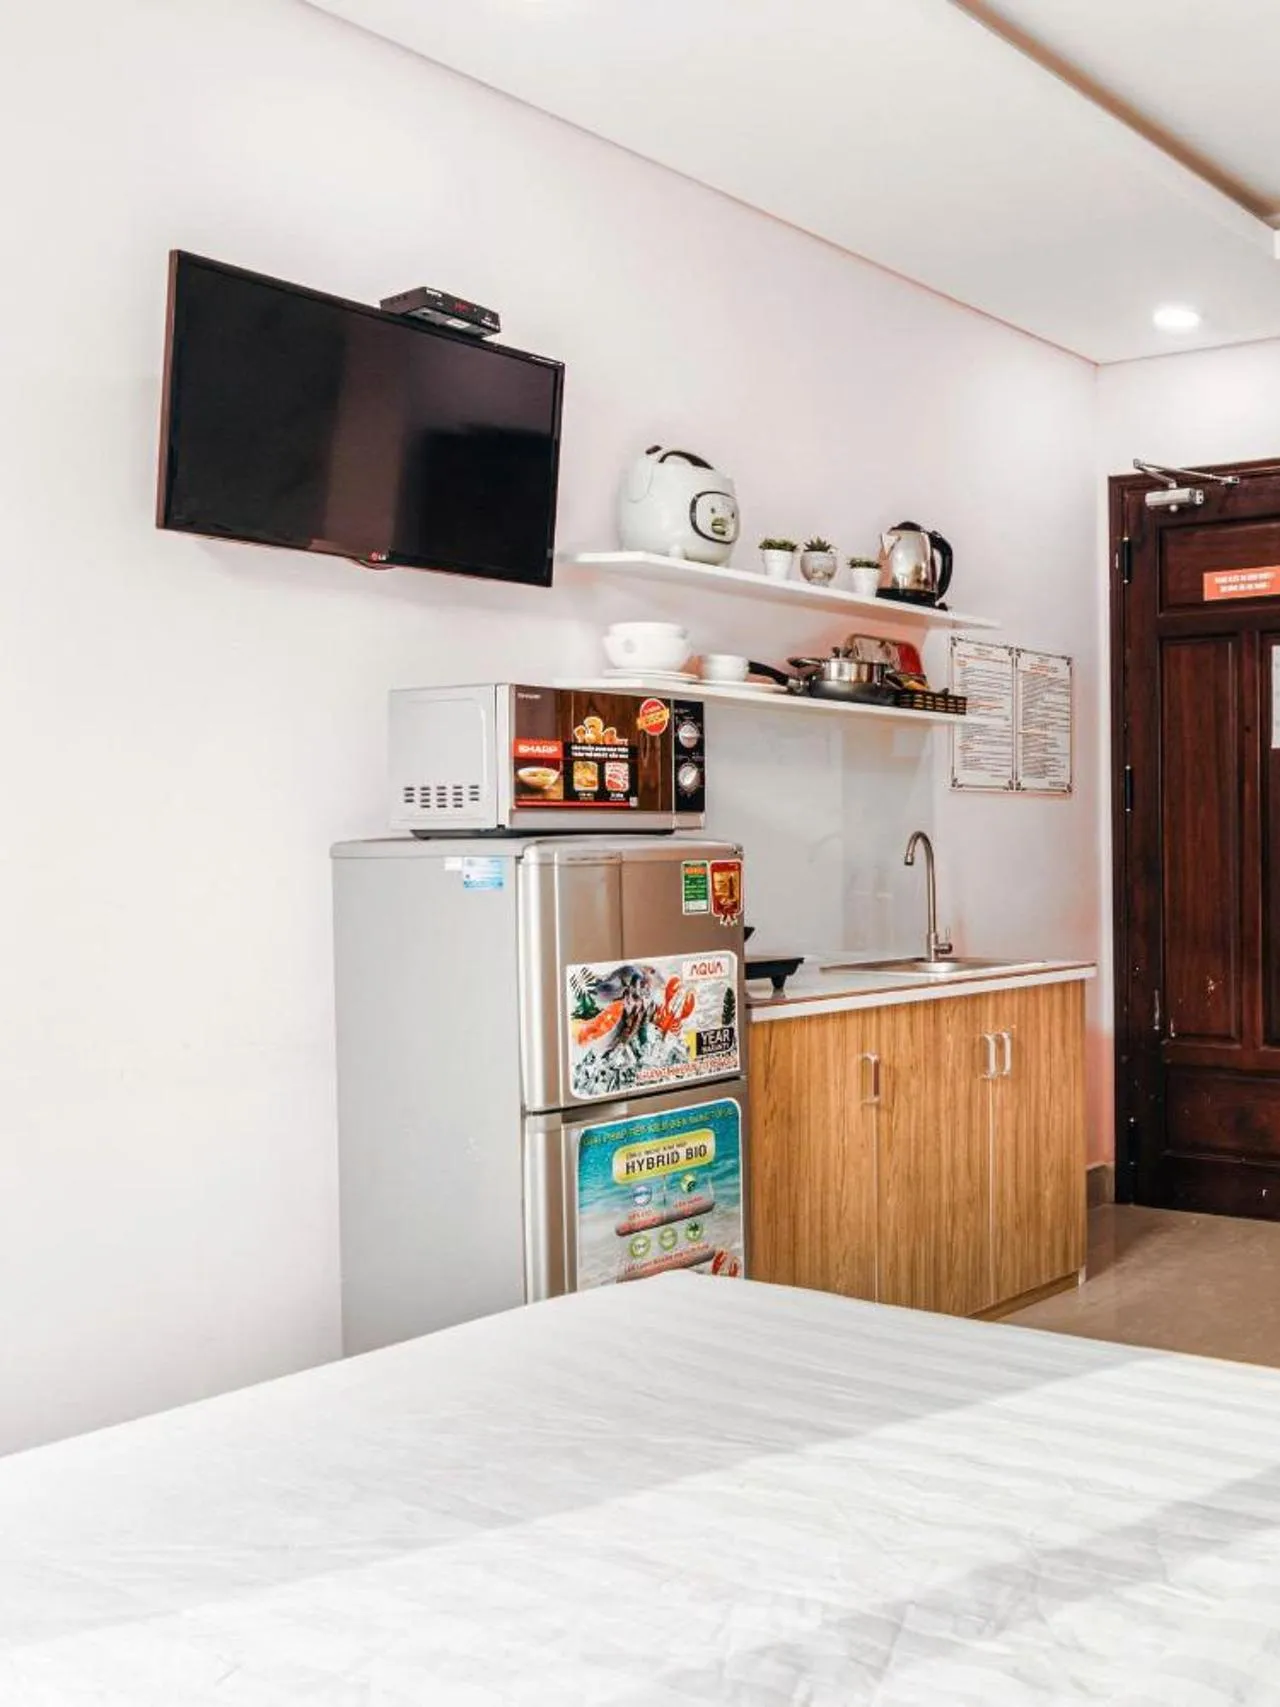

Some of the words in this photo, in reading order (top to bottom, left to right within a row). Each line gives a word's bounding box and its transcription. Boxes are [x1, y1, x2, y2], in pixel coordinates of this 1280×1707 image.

[518, 743, 557, 754] SHARP
[690, 961, 723, 976] AQUA
[700, 1028, 731, 1046] YEAR
[626, 1151, 680, 1175] HYBRID
[685, 1144, 707, 1160] BIO
